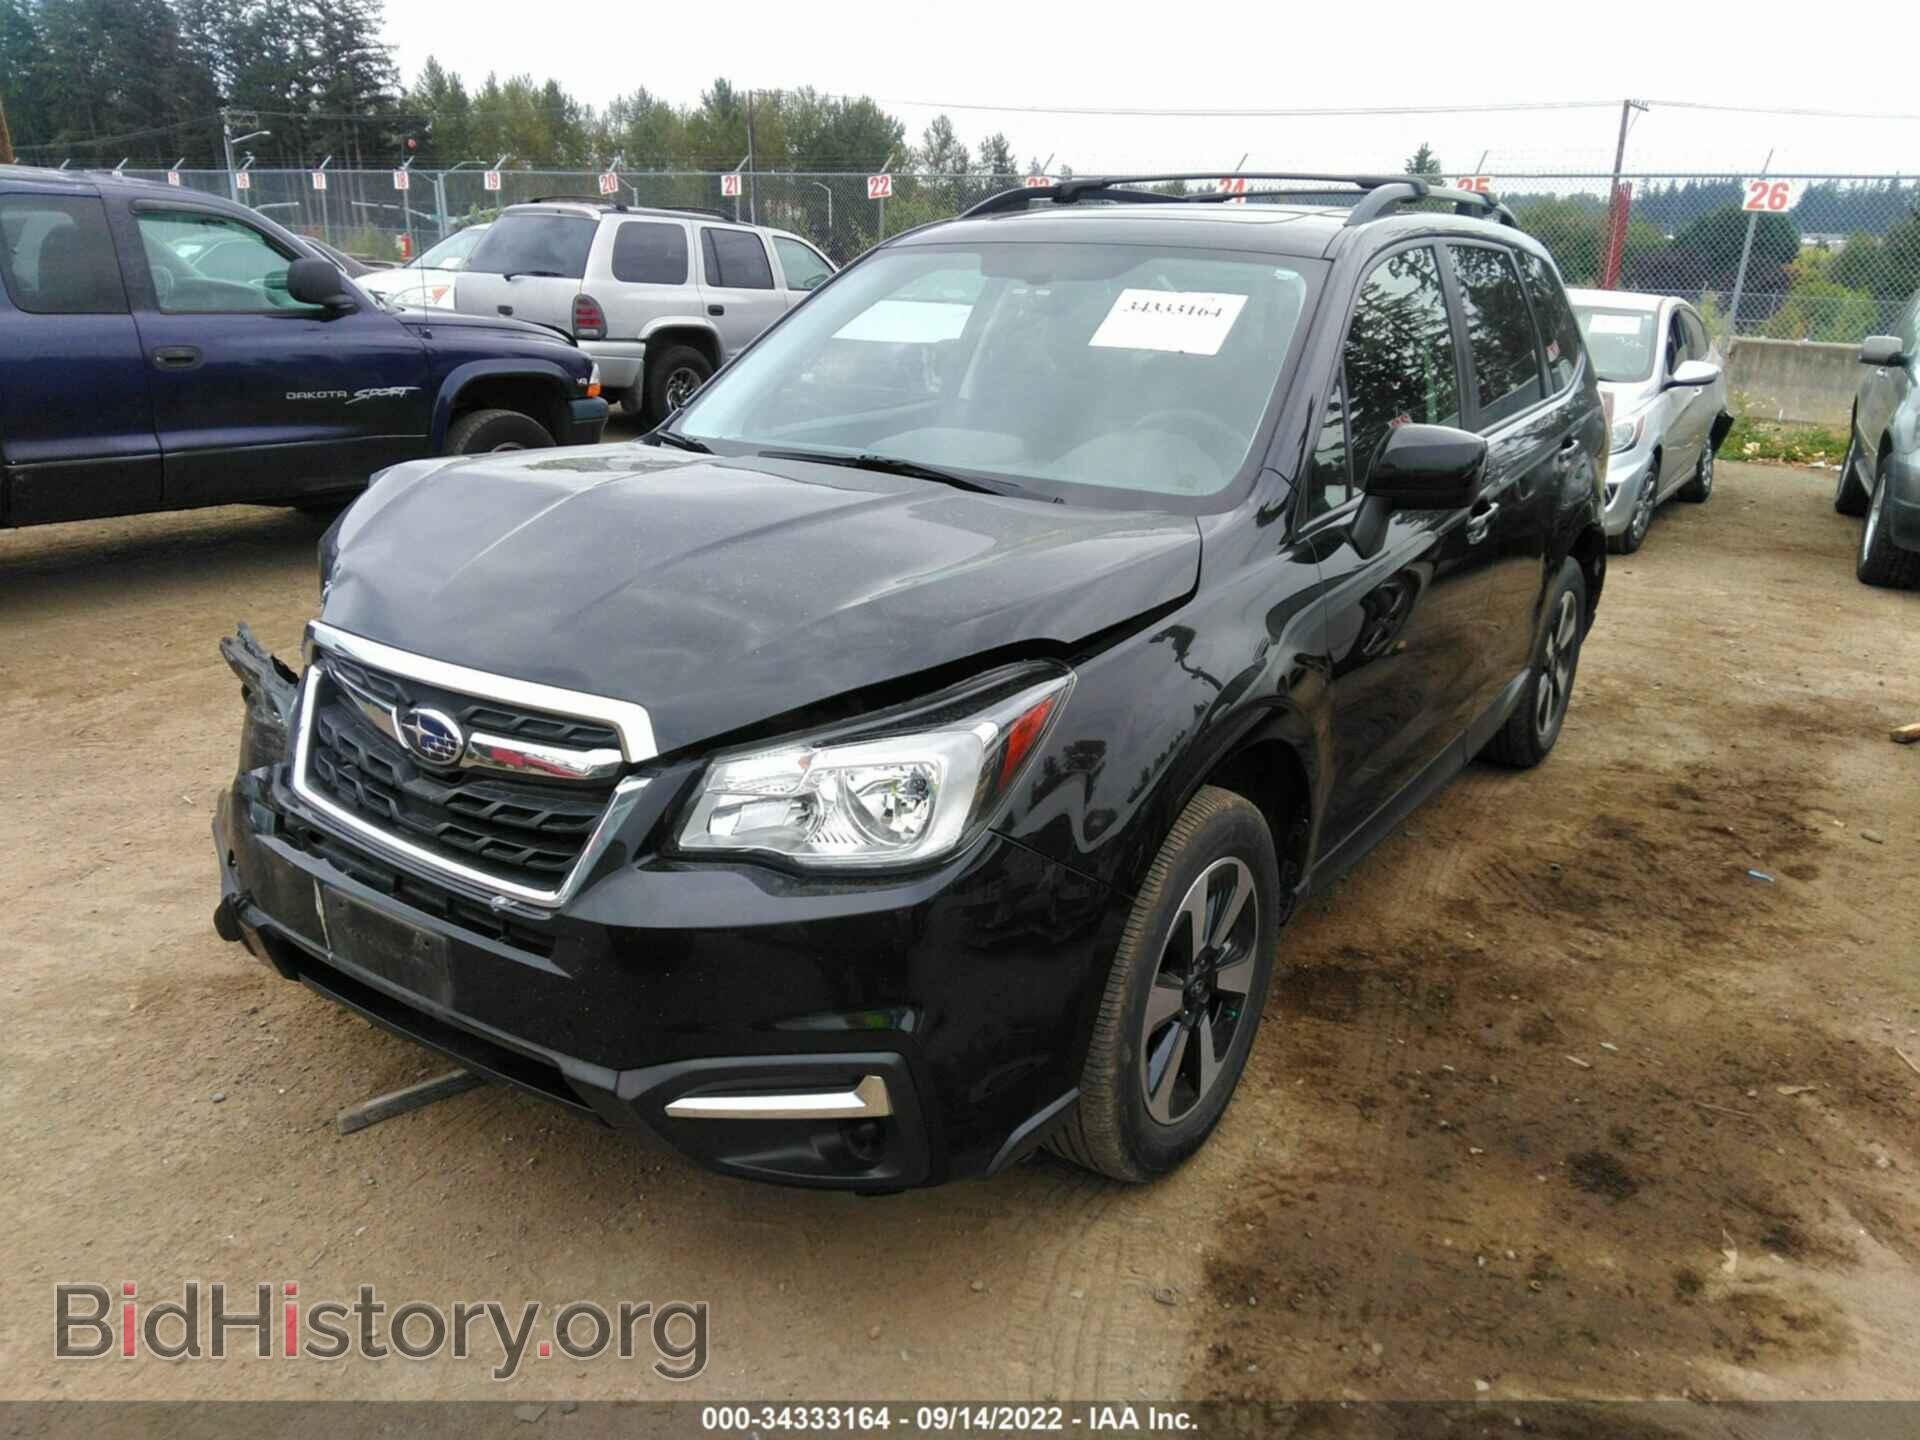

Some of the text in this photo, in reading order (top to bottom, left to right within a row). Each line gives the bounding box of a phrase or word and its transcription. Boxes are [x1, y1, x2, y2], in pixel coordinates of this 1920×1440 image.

[315, 173, 324, 188] 17
[396, 173, 407, 188] 18
[486, 173, 498, 189] 19
[600, 174, 616, 193] 20
[724, 175, 738, 194] 21
[869, 175, 890, 197] 22
[1746, 181, 1790, 210] 26
[285, 386, 421, 404] DAKOTA SPORT
